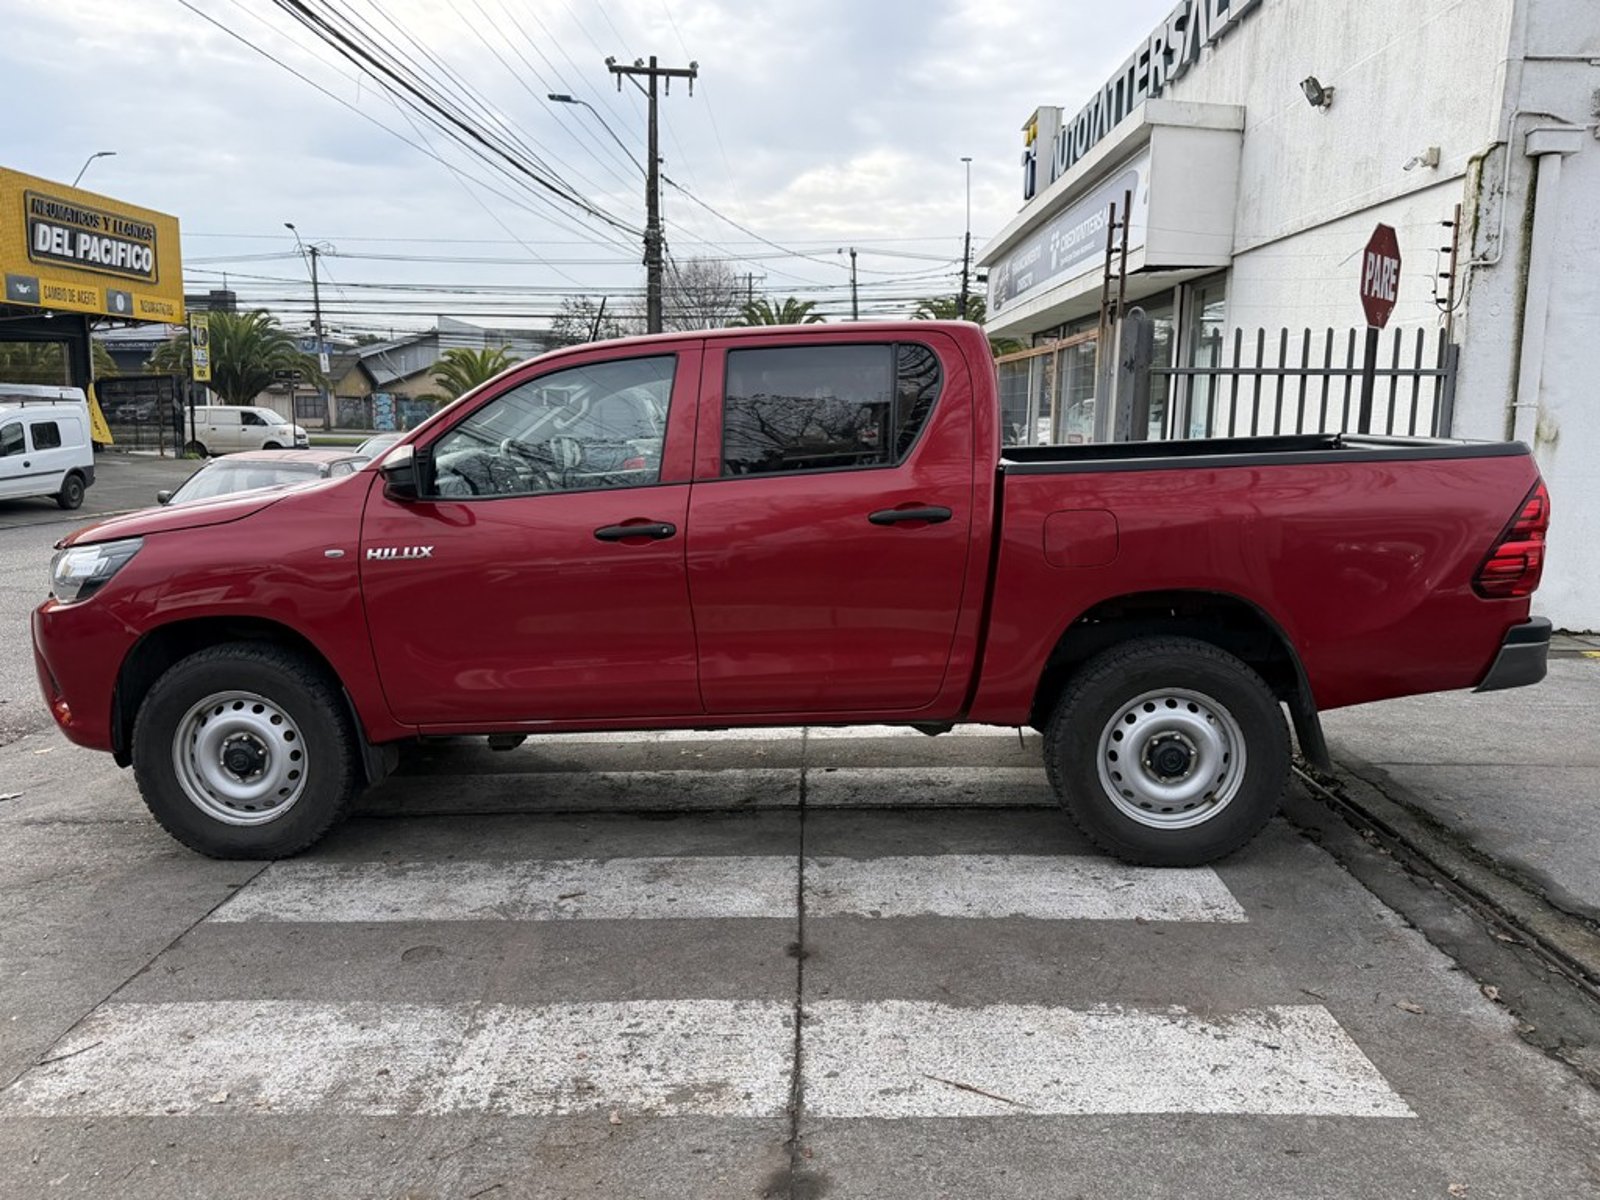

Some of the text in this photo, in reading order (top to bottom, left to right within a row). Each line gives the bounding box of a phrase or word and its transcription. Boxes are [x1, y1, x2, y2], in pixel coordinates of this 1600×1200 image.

[32, 198, 100, 229] NEUMATICOS
[103, 216, 111, 232] Y
[34, 223, 153, 272] DEL PACIFICO
[1364, 251, 1399, 302] PARE
[366, 546, 434, 560] HILUX
